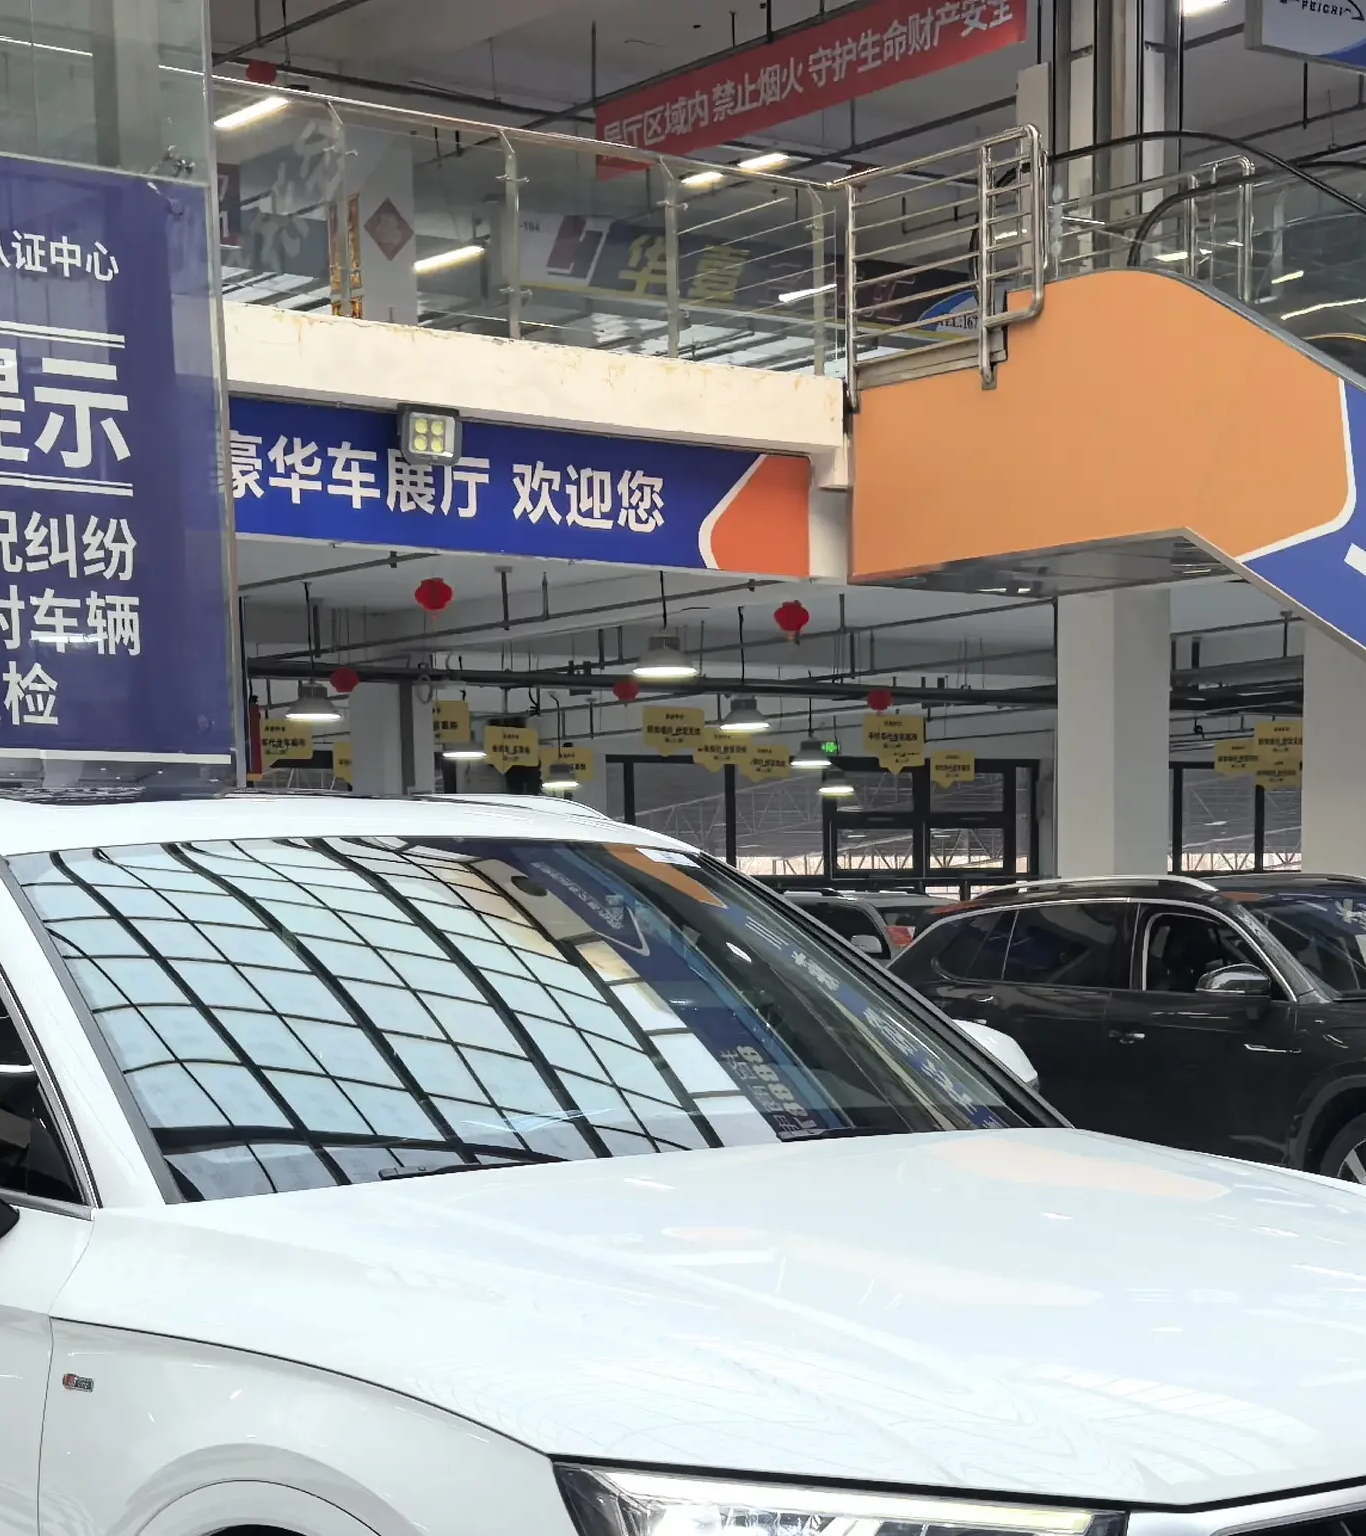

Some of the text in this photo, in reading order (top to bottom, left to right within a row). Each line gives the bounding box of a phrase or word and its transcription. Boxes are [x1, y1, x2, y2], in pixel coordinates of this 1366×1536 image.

[712, 57, 804, 122] 禁止烟火
[512, 460, 665, 533] 欢迎您
